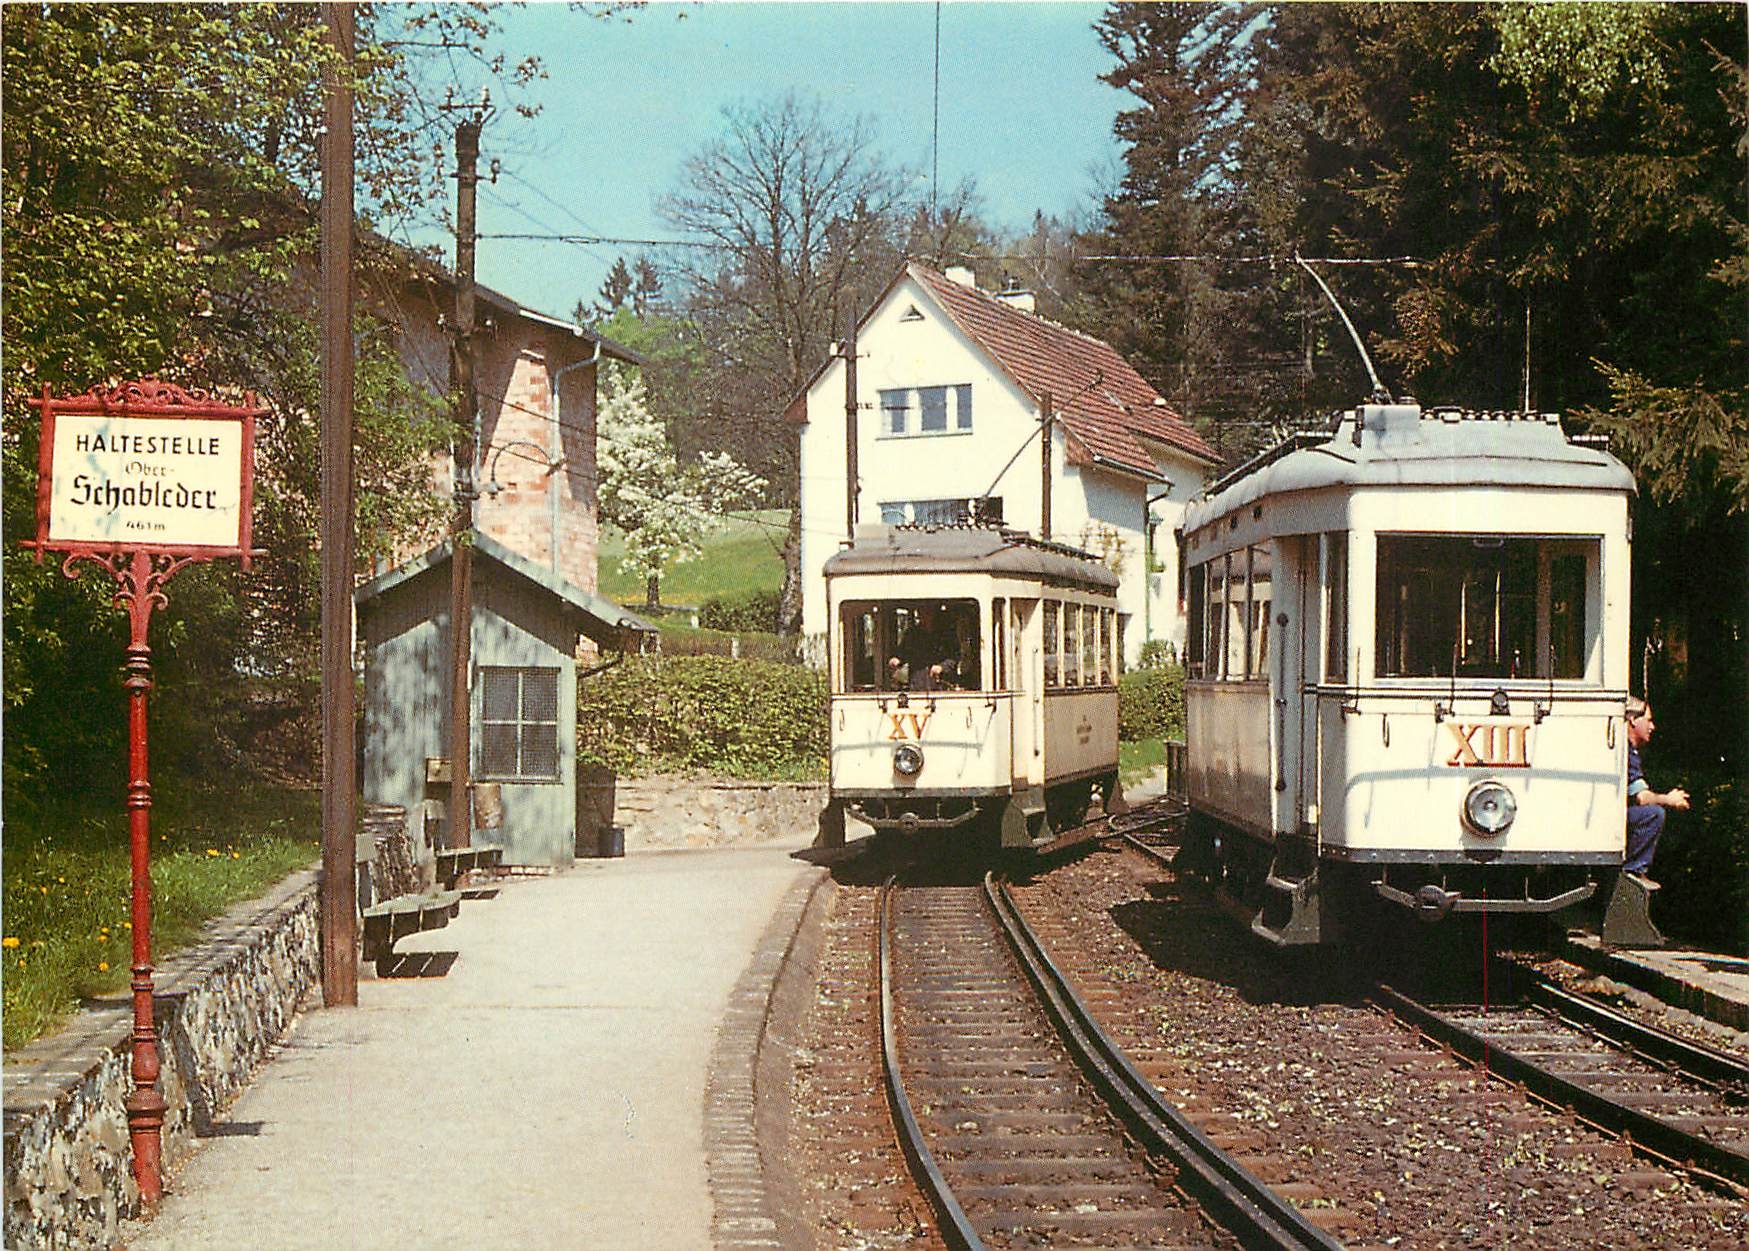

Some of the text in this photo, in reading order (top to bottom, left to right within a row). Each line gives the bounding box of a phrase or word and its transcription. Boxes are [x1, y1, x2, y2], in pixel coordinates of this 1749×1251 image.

[76, 434, 219, 455] HALTESTELLE
[70, 475, 217, 515] Schableder
[888, 713, 931, 740] XV
[1445, 723, 1531, 768] XIII
